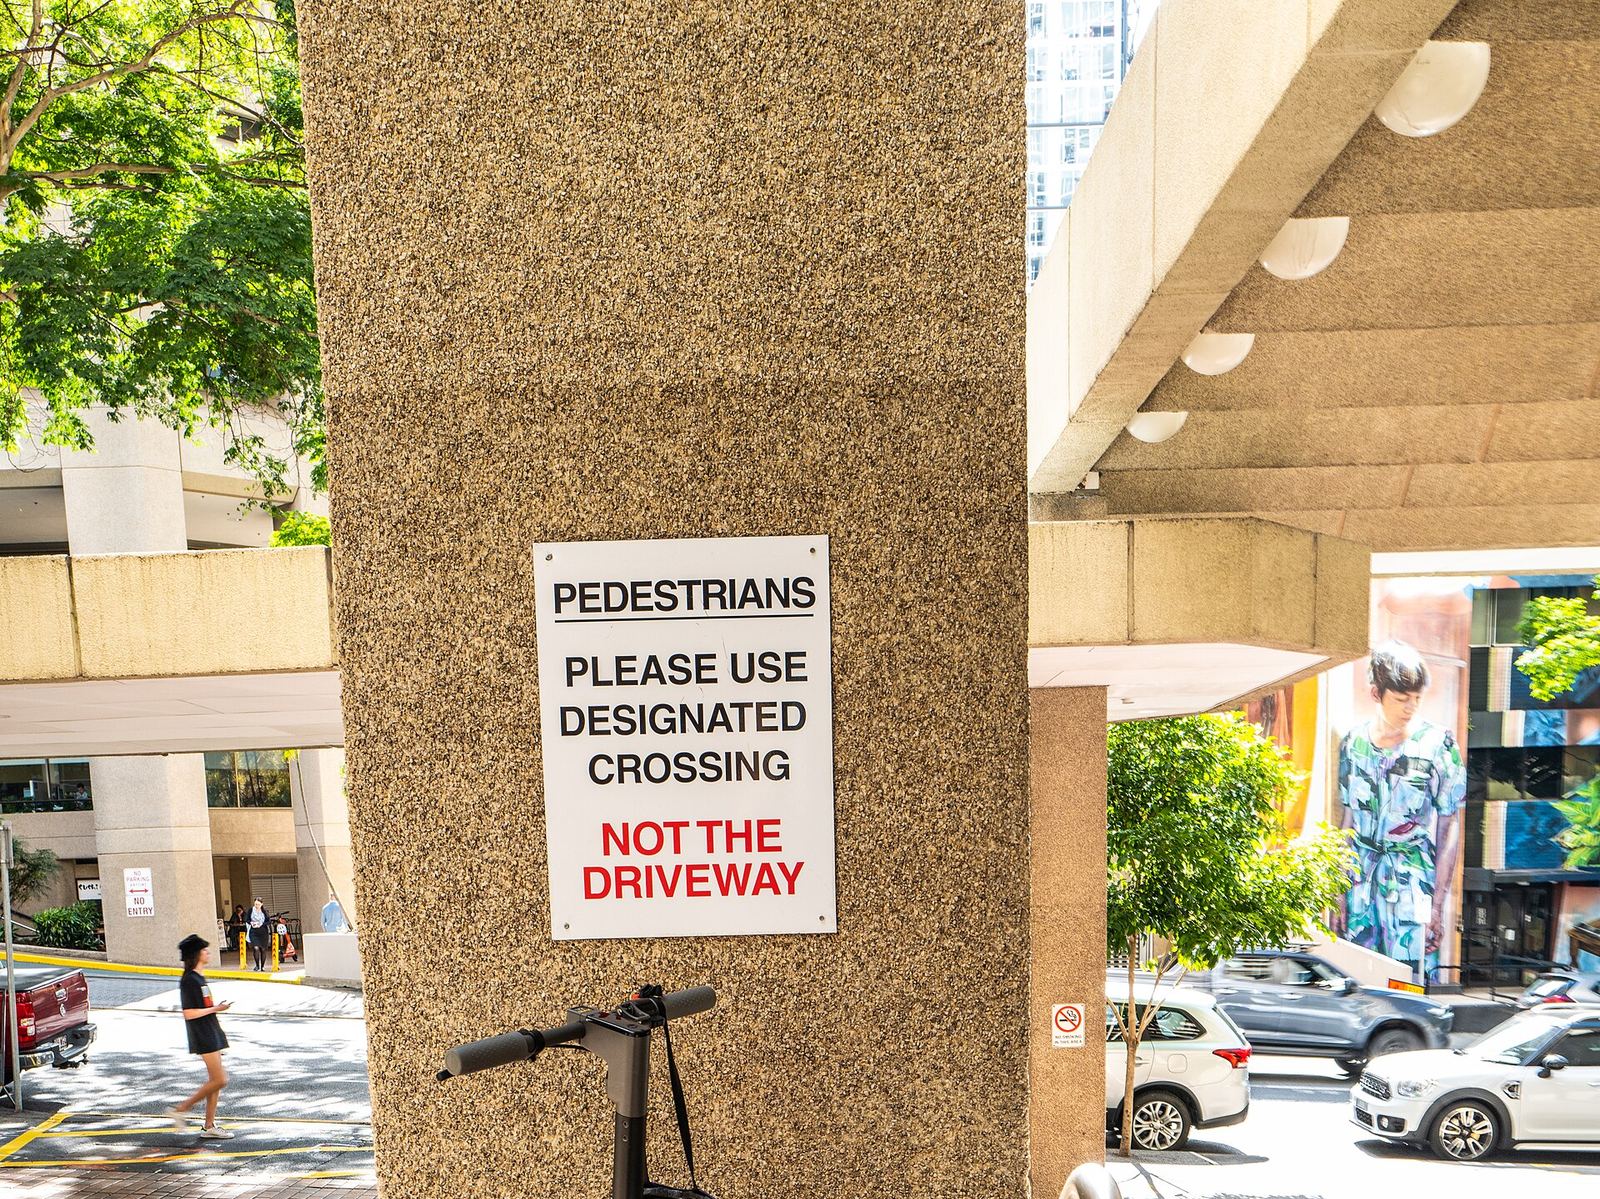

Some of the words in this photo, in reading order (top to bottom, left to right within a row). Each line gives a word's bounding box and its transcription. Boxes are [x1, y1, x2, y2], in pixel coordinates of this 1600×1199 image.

[554, 577, 815, 613] PEDESTRIANS
[566, 654, 717, 687] PLEASE
[731, 652, 807, 683] USE
[560, 701, 806, 736] DESIGNATED
[589, 750, 789, 785] CROSSING
[602, 821, 689, 856] NOT
[697, 819, 782, 853] THE
[583, 862, 804, 899] DRIVEWAY
[128, 907, 153, 915] ENTRY
[133, 897, 145, 905] NO
